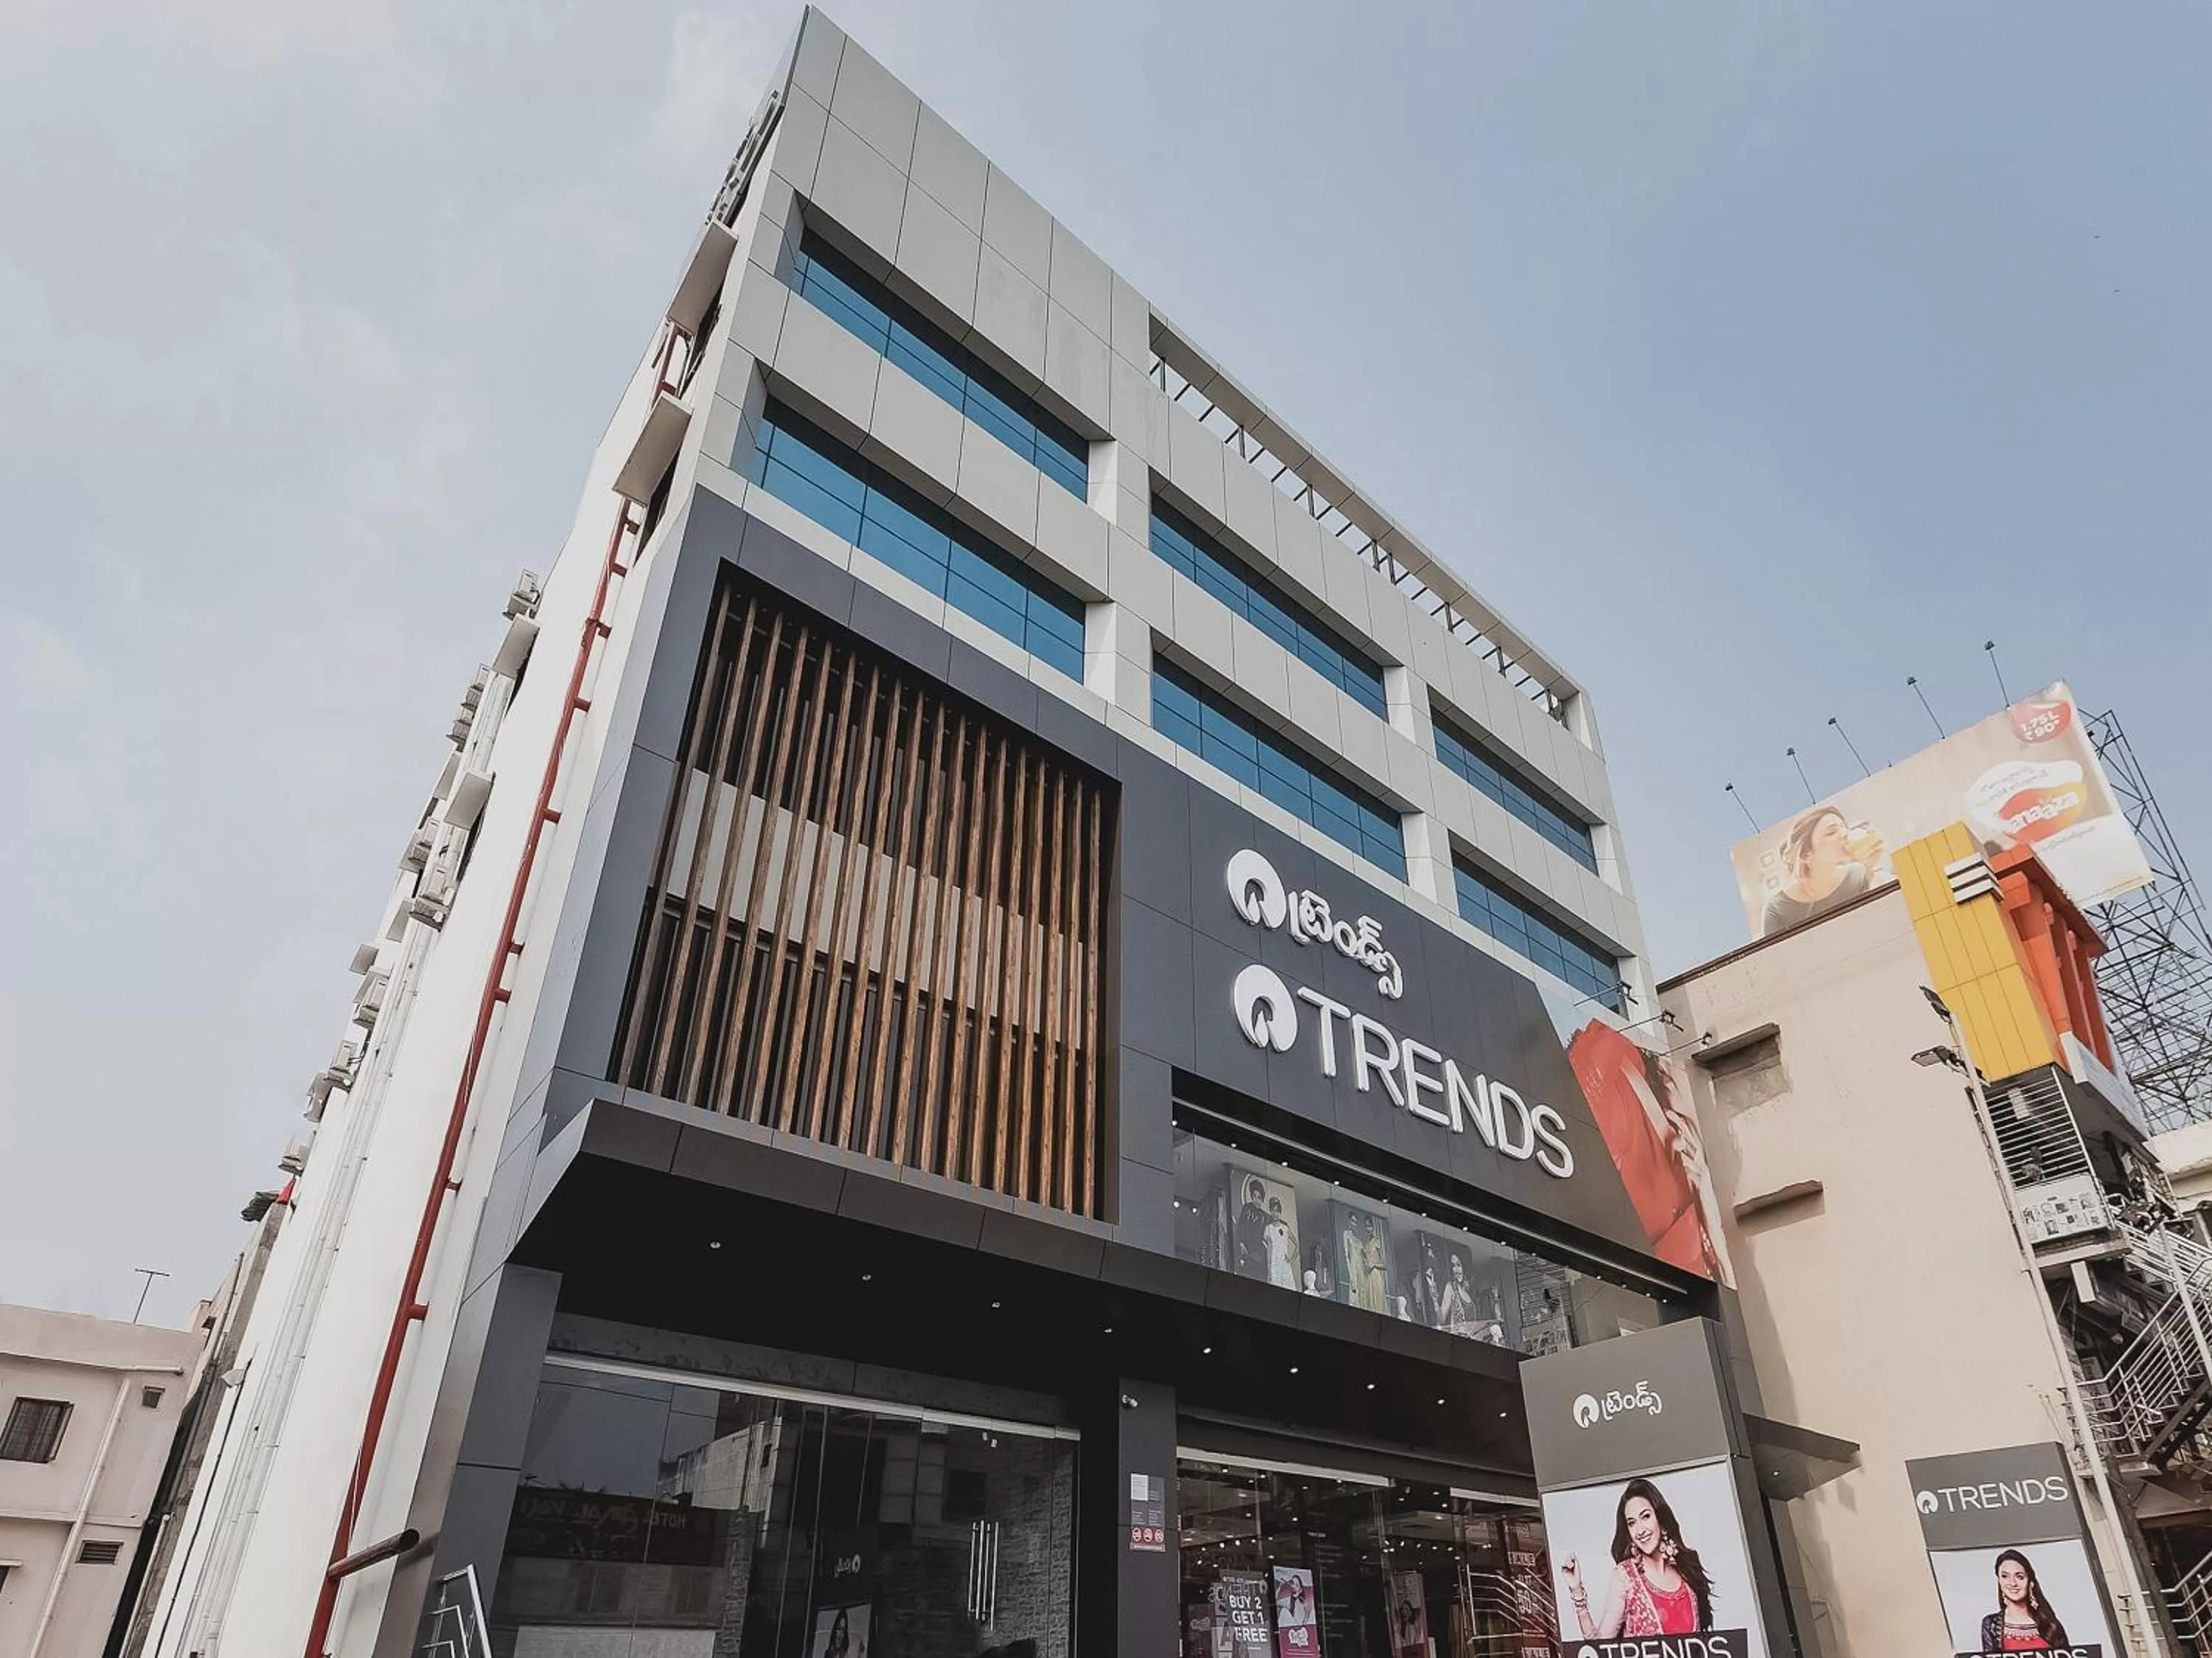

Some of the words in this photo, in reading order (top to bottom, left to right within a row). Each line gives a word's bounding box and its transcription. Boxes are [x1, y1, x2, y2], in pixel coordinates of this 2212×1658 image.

[1297, 985, 1576, 1179] TRENDS
[1937, 1476, 2068, 1512] TRENDS
[1229, 1595, 1251, 1609] BUY
[1254, 1596, 1262, 1609] 2
[1232, 1610, 1255, 1625] GET
[1258, 1611, 1264, 1625] 1
